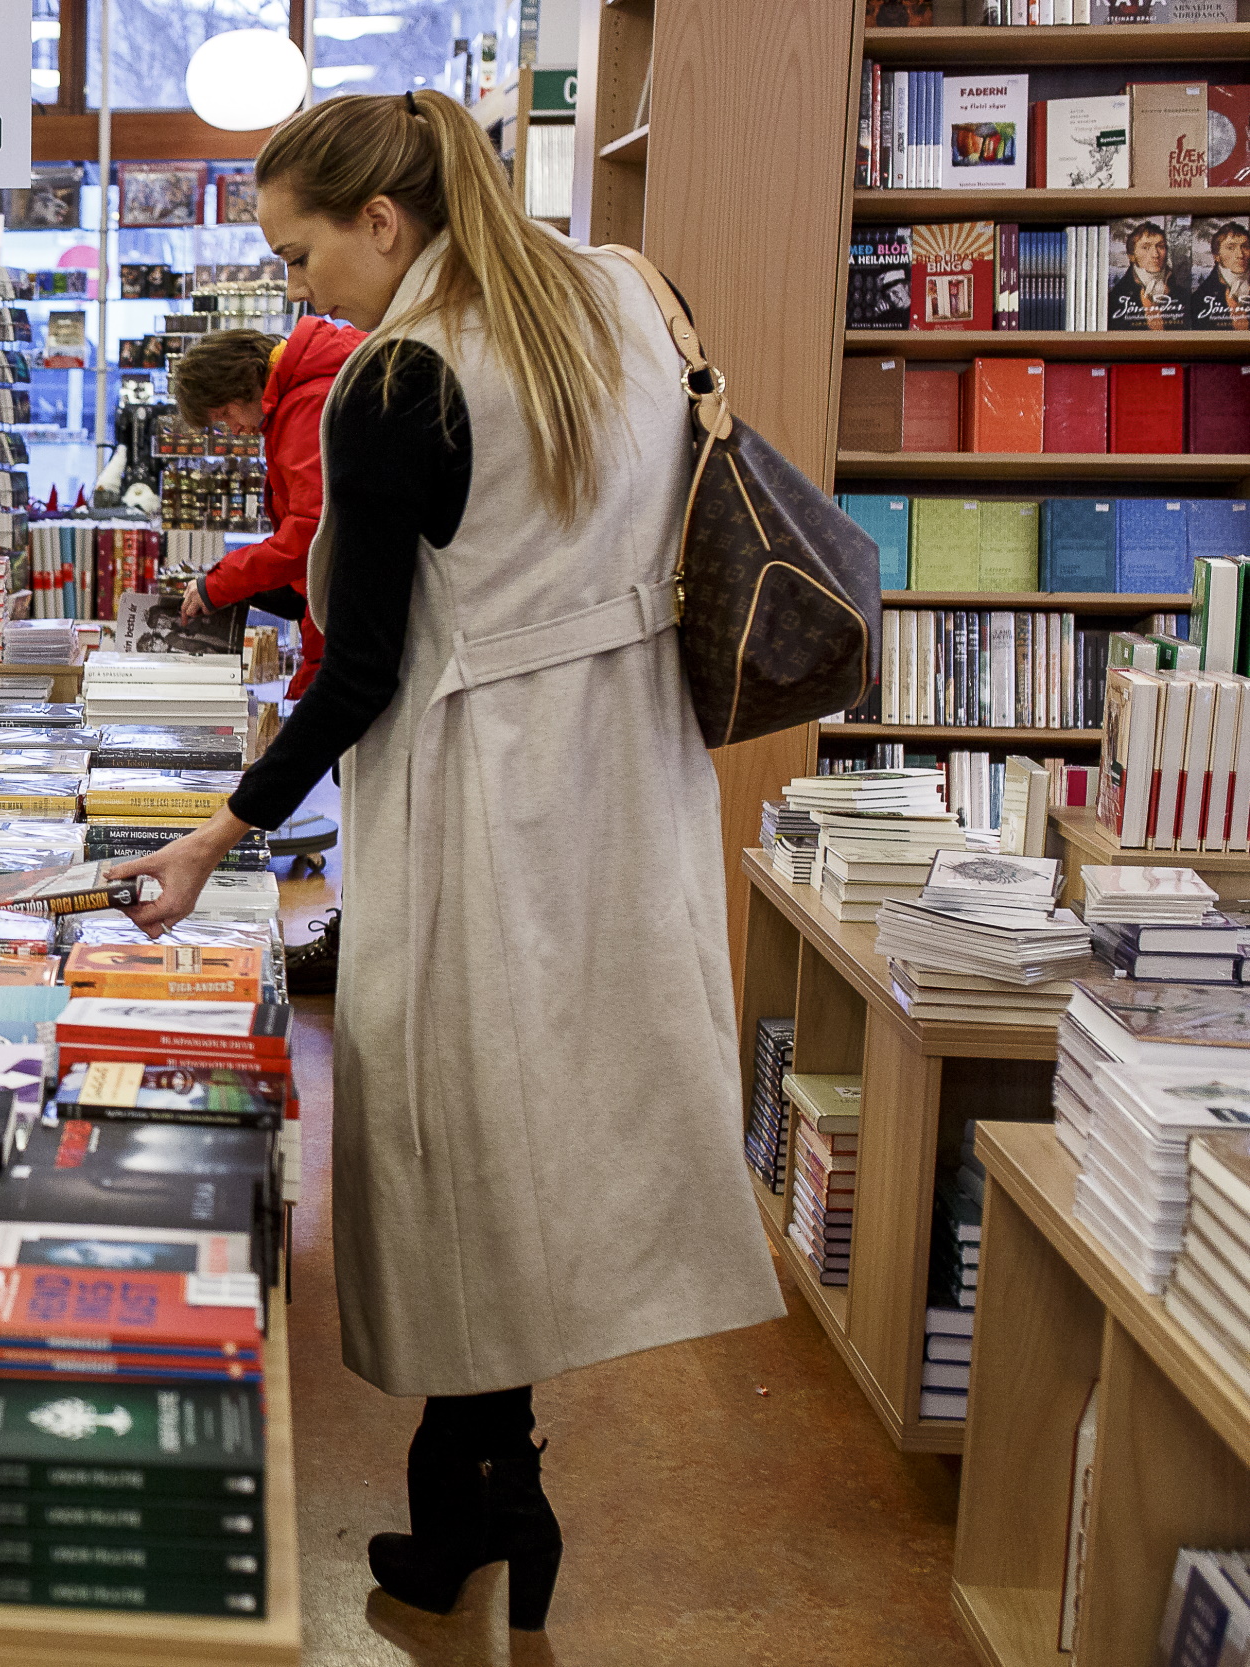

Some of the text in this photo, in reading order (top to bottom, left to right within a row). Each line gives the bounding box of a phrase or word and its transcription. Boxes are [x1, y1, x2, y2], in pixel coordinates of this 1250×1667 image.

[858, 254, 909, 265] HEILANUM
[109, 831, 184, 840] MARY HIGGINS CLARK
[114, 849, 134, 857] MARY
[50, 896, 74, 914] BOGI
[73, 891, 110, 912] ARASON
